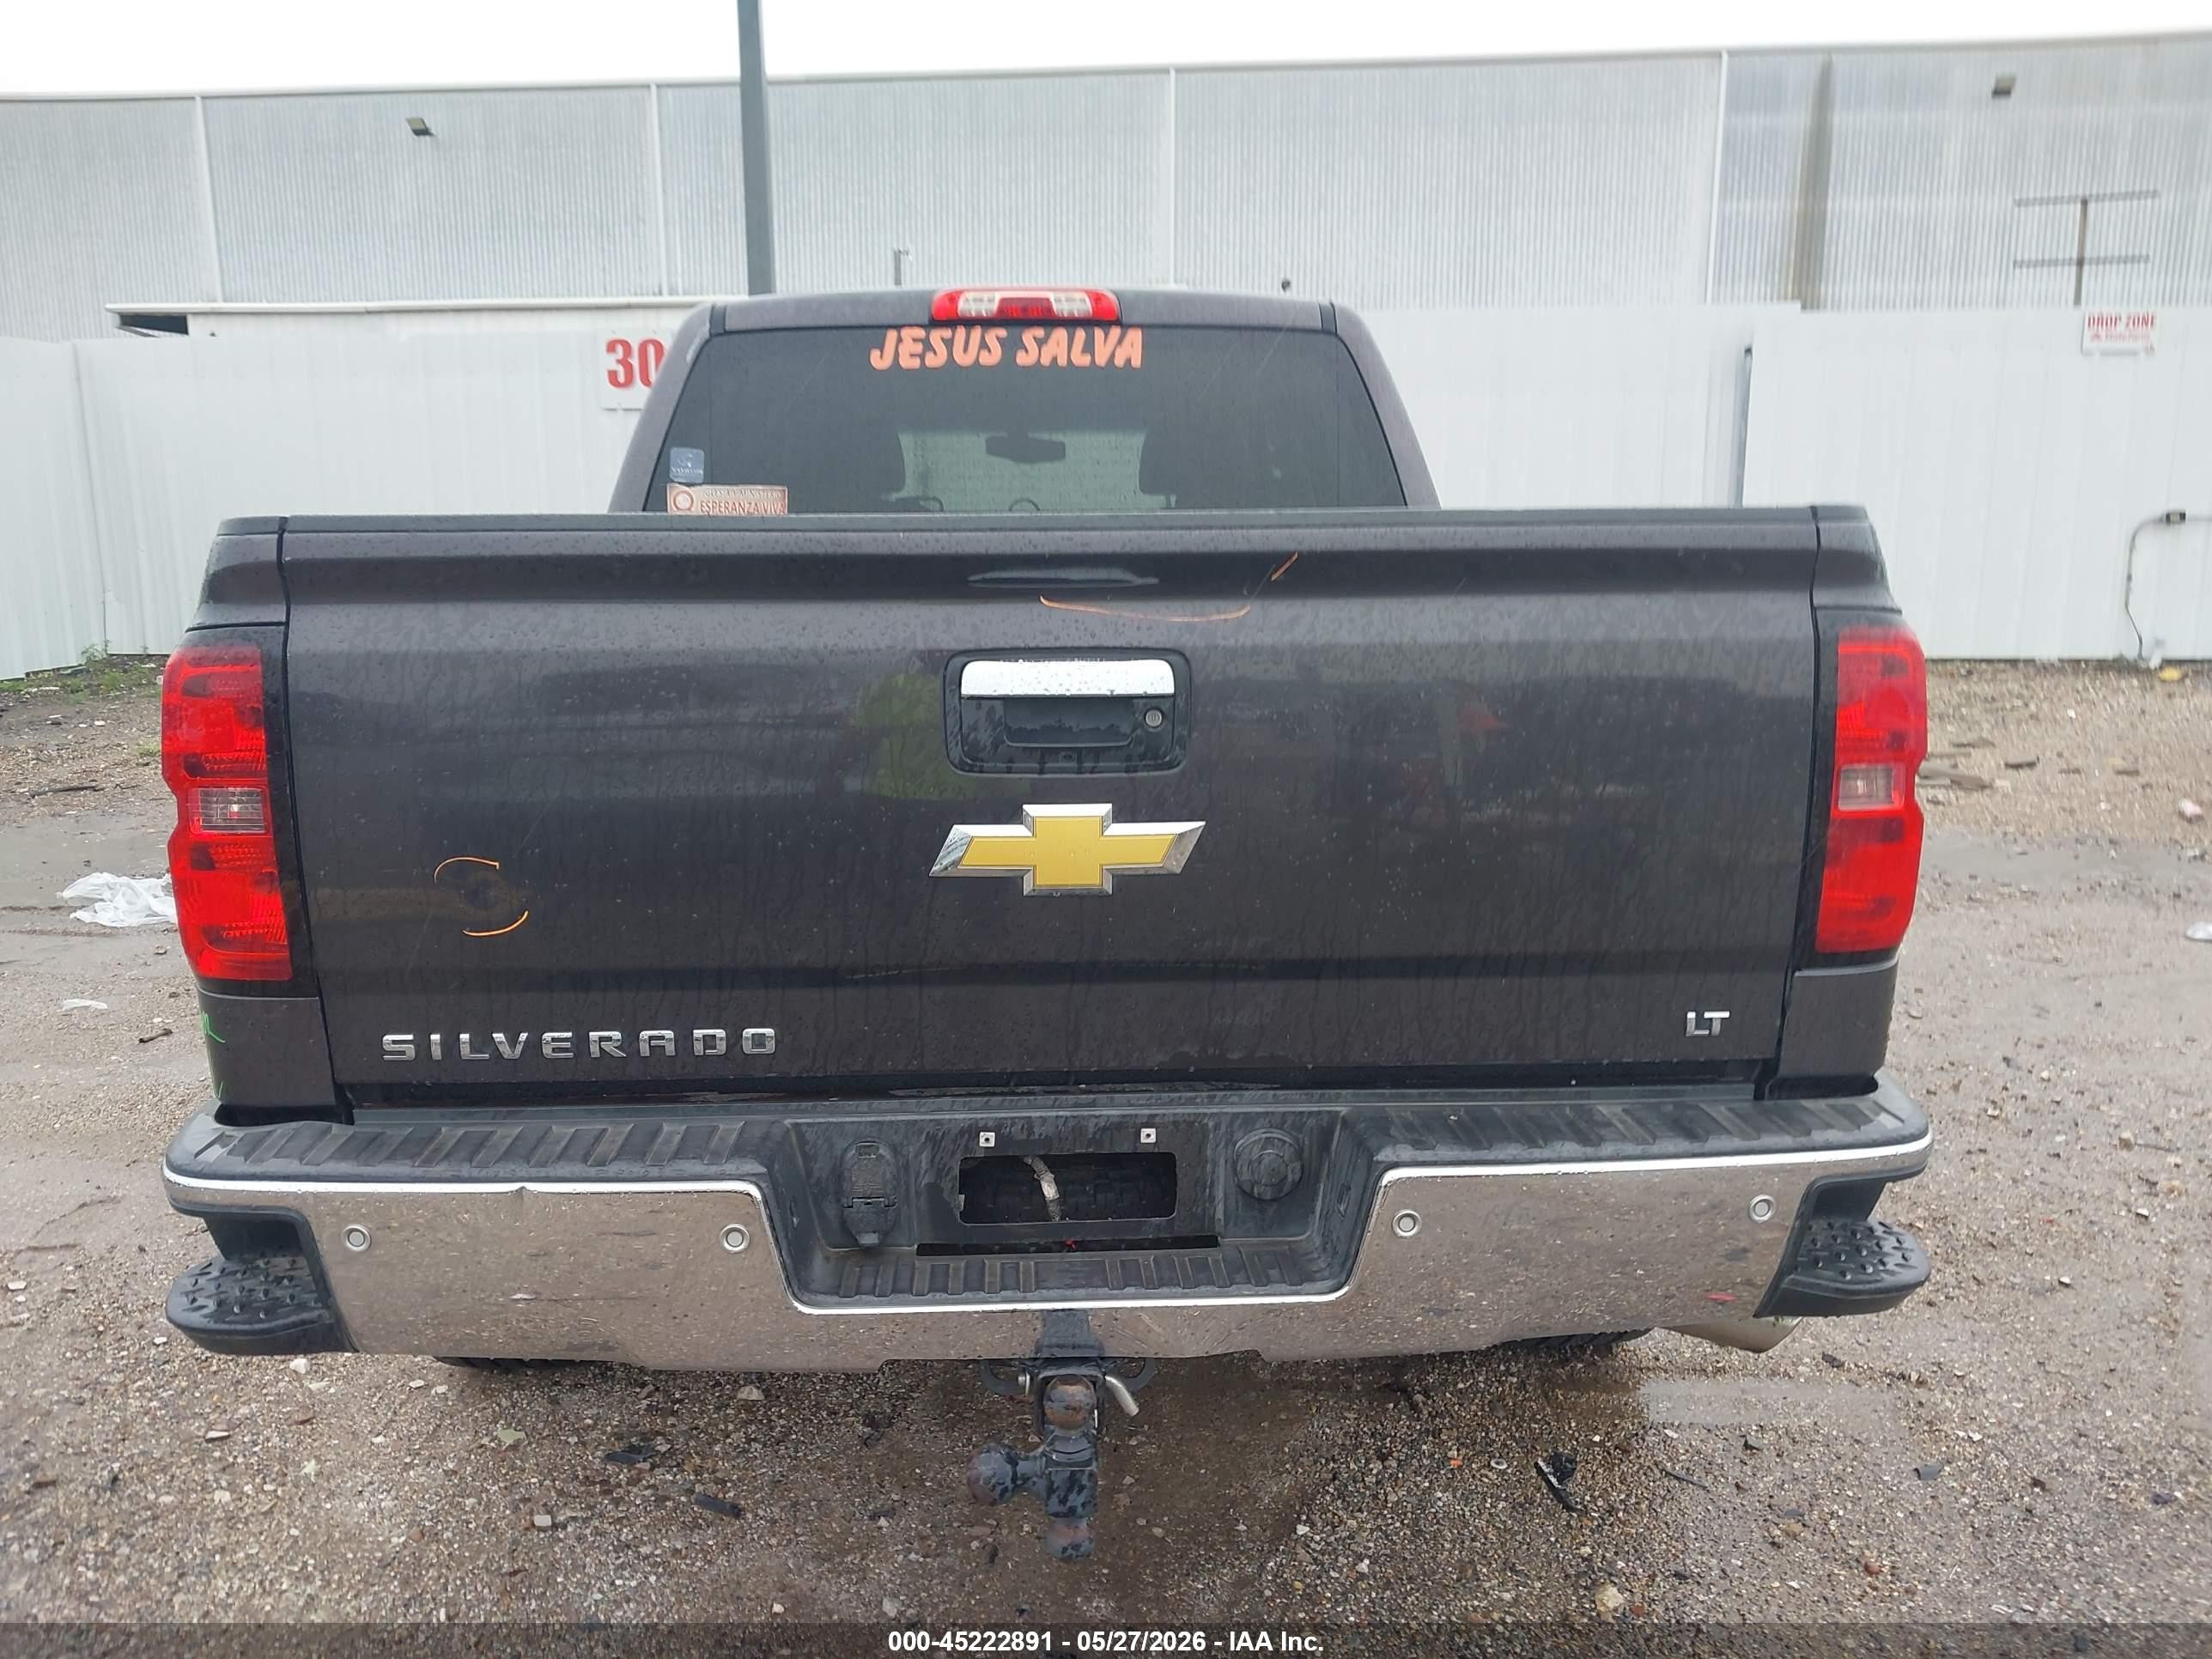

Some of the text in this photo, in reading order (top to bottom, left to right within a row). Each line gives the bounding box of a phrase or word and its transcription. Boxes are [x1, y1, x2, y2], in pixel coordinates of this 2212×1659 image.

[2087, 313, 2122, 328] DROP
[869, 324, 1143, 371] JESUS SALVA
[605, 338, 665, 390] 30
[700, 501, 759, 515] ESPERANZA
[1685, 1010, 1731, 1037] LT
[381, 1027, 776, 1062] SILVERADO
